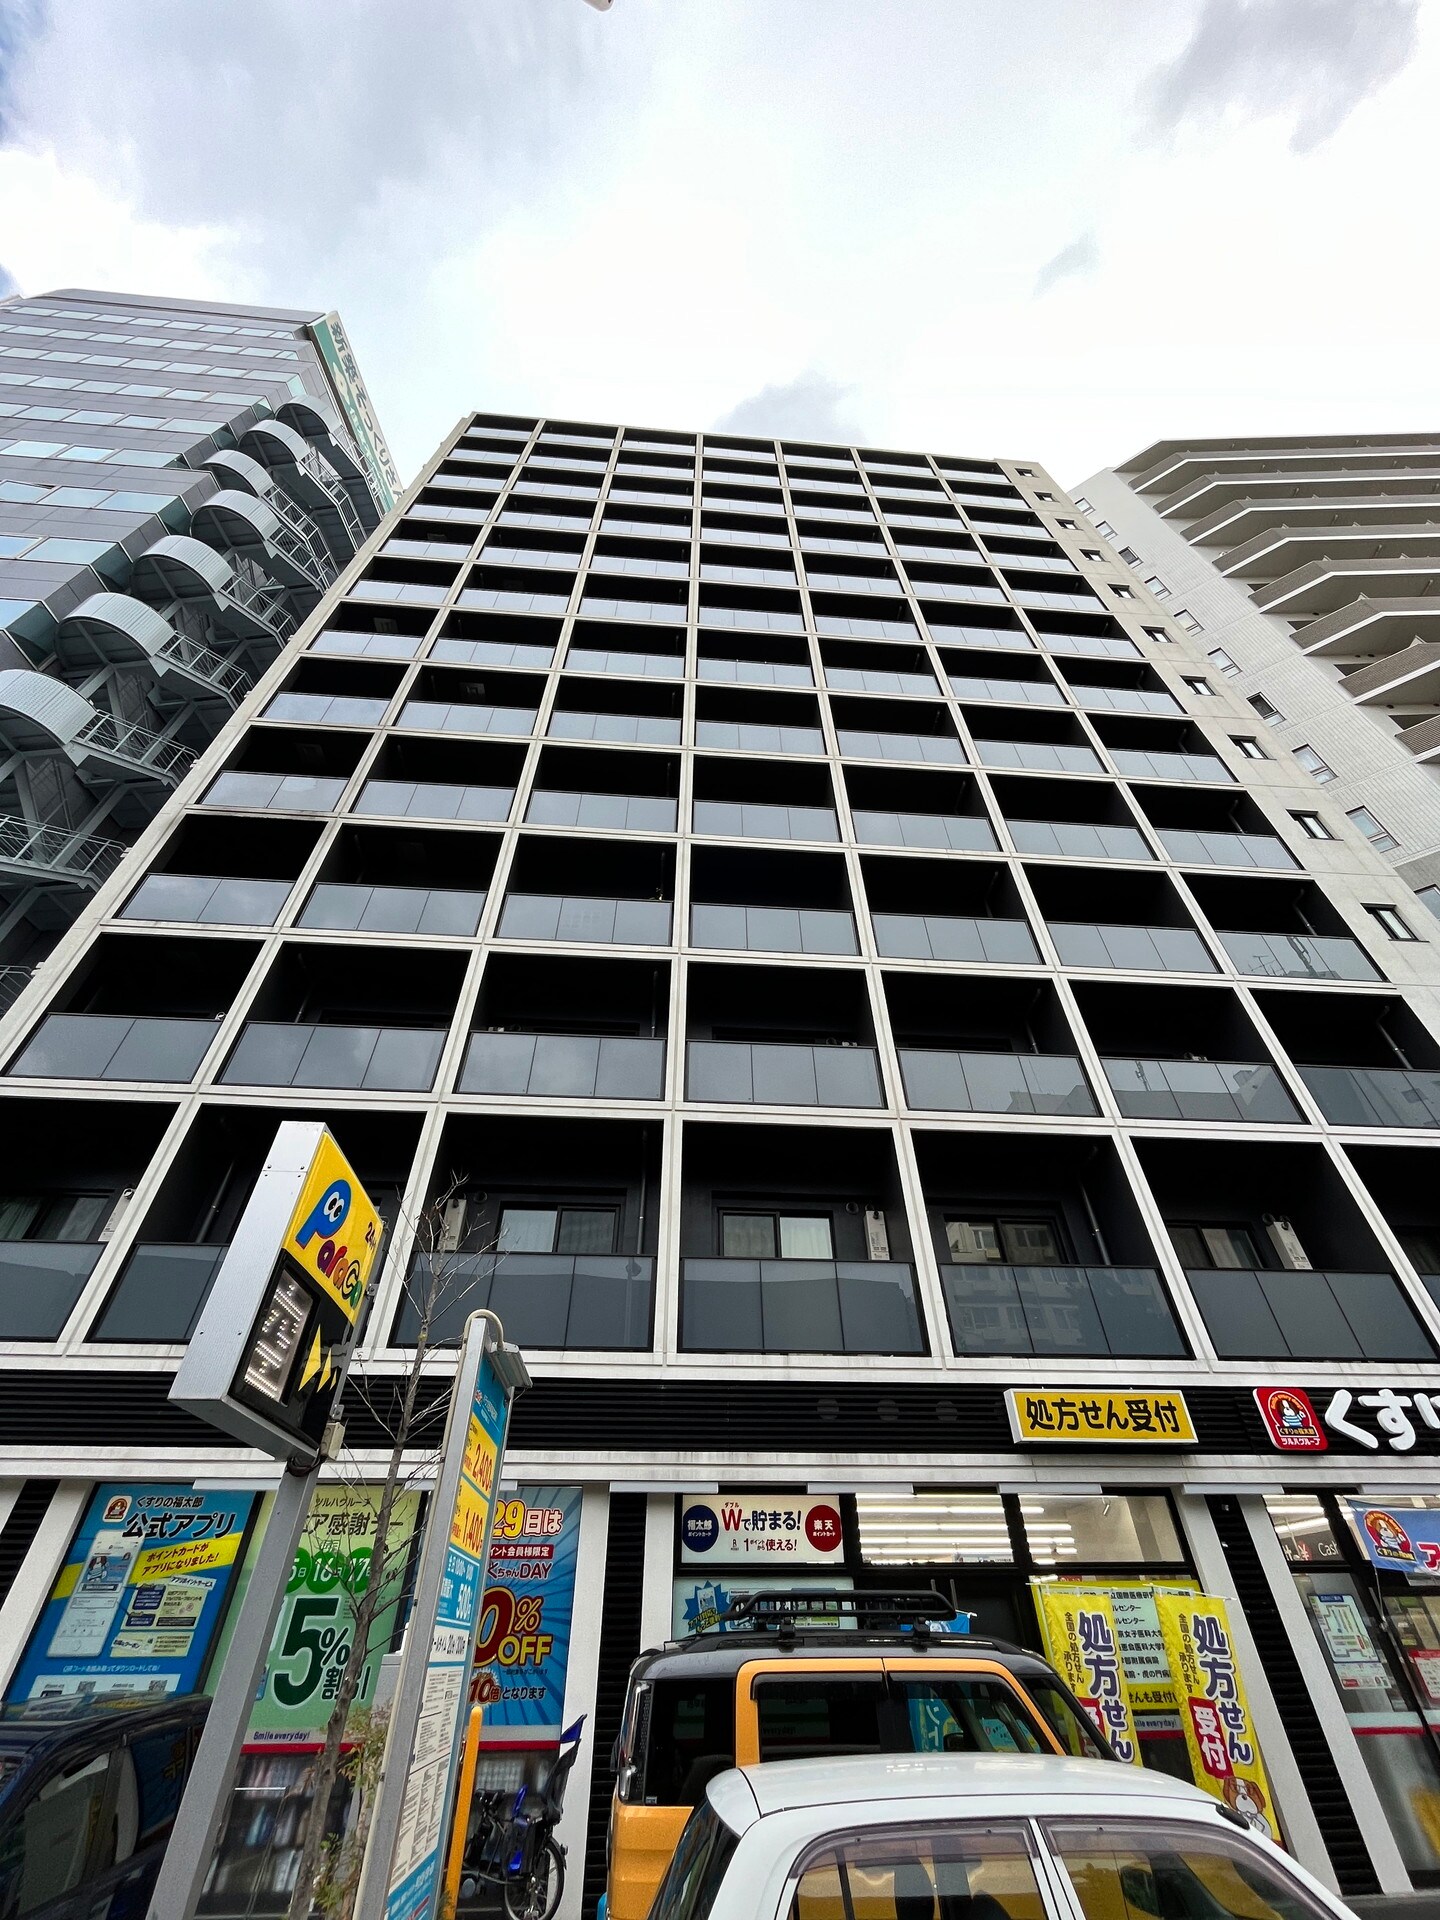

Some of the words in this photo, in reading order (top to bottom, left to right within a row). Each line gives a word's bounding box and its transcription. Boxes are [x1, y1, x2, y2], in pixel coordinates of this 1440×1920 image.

[1026, 1397, 1180, 1433] 処方せん受付
[136, 1496, 205, 1509] くすりの福太郎
[121, 1512, 236, 1539] 公式アプリ
[687, 1519, 713, 1531] 福太郎
[721, 1509, 802, 1532] Wで貯まる!
[813, 1519, 834, 1531] 楽天
[147, 1541, 209, 1563] ポイントカードが
[497, 1634, 553, 1666] OFF
[1064, 1611, 1085, 1685] 全国の処方せん
[1178, 1613, 1200, 1686] 全国の処方せん
[1078, 1610, 1135, 1761] 処方せん
[1178, 1651, 1193, 1694] 承ります
[1192, 1614, 1251, 1763] 処方せん
[502, 1686, 547, 1700] となります
[1193, 1705, 1227, 1772] 受付
